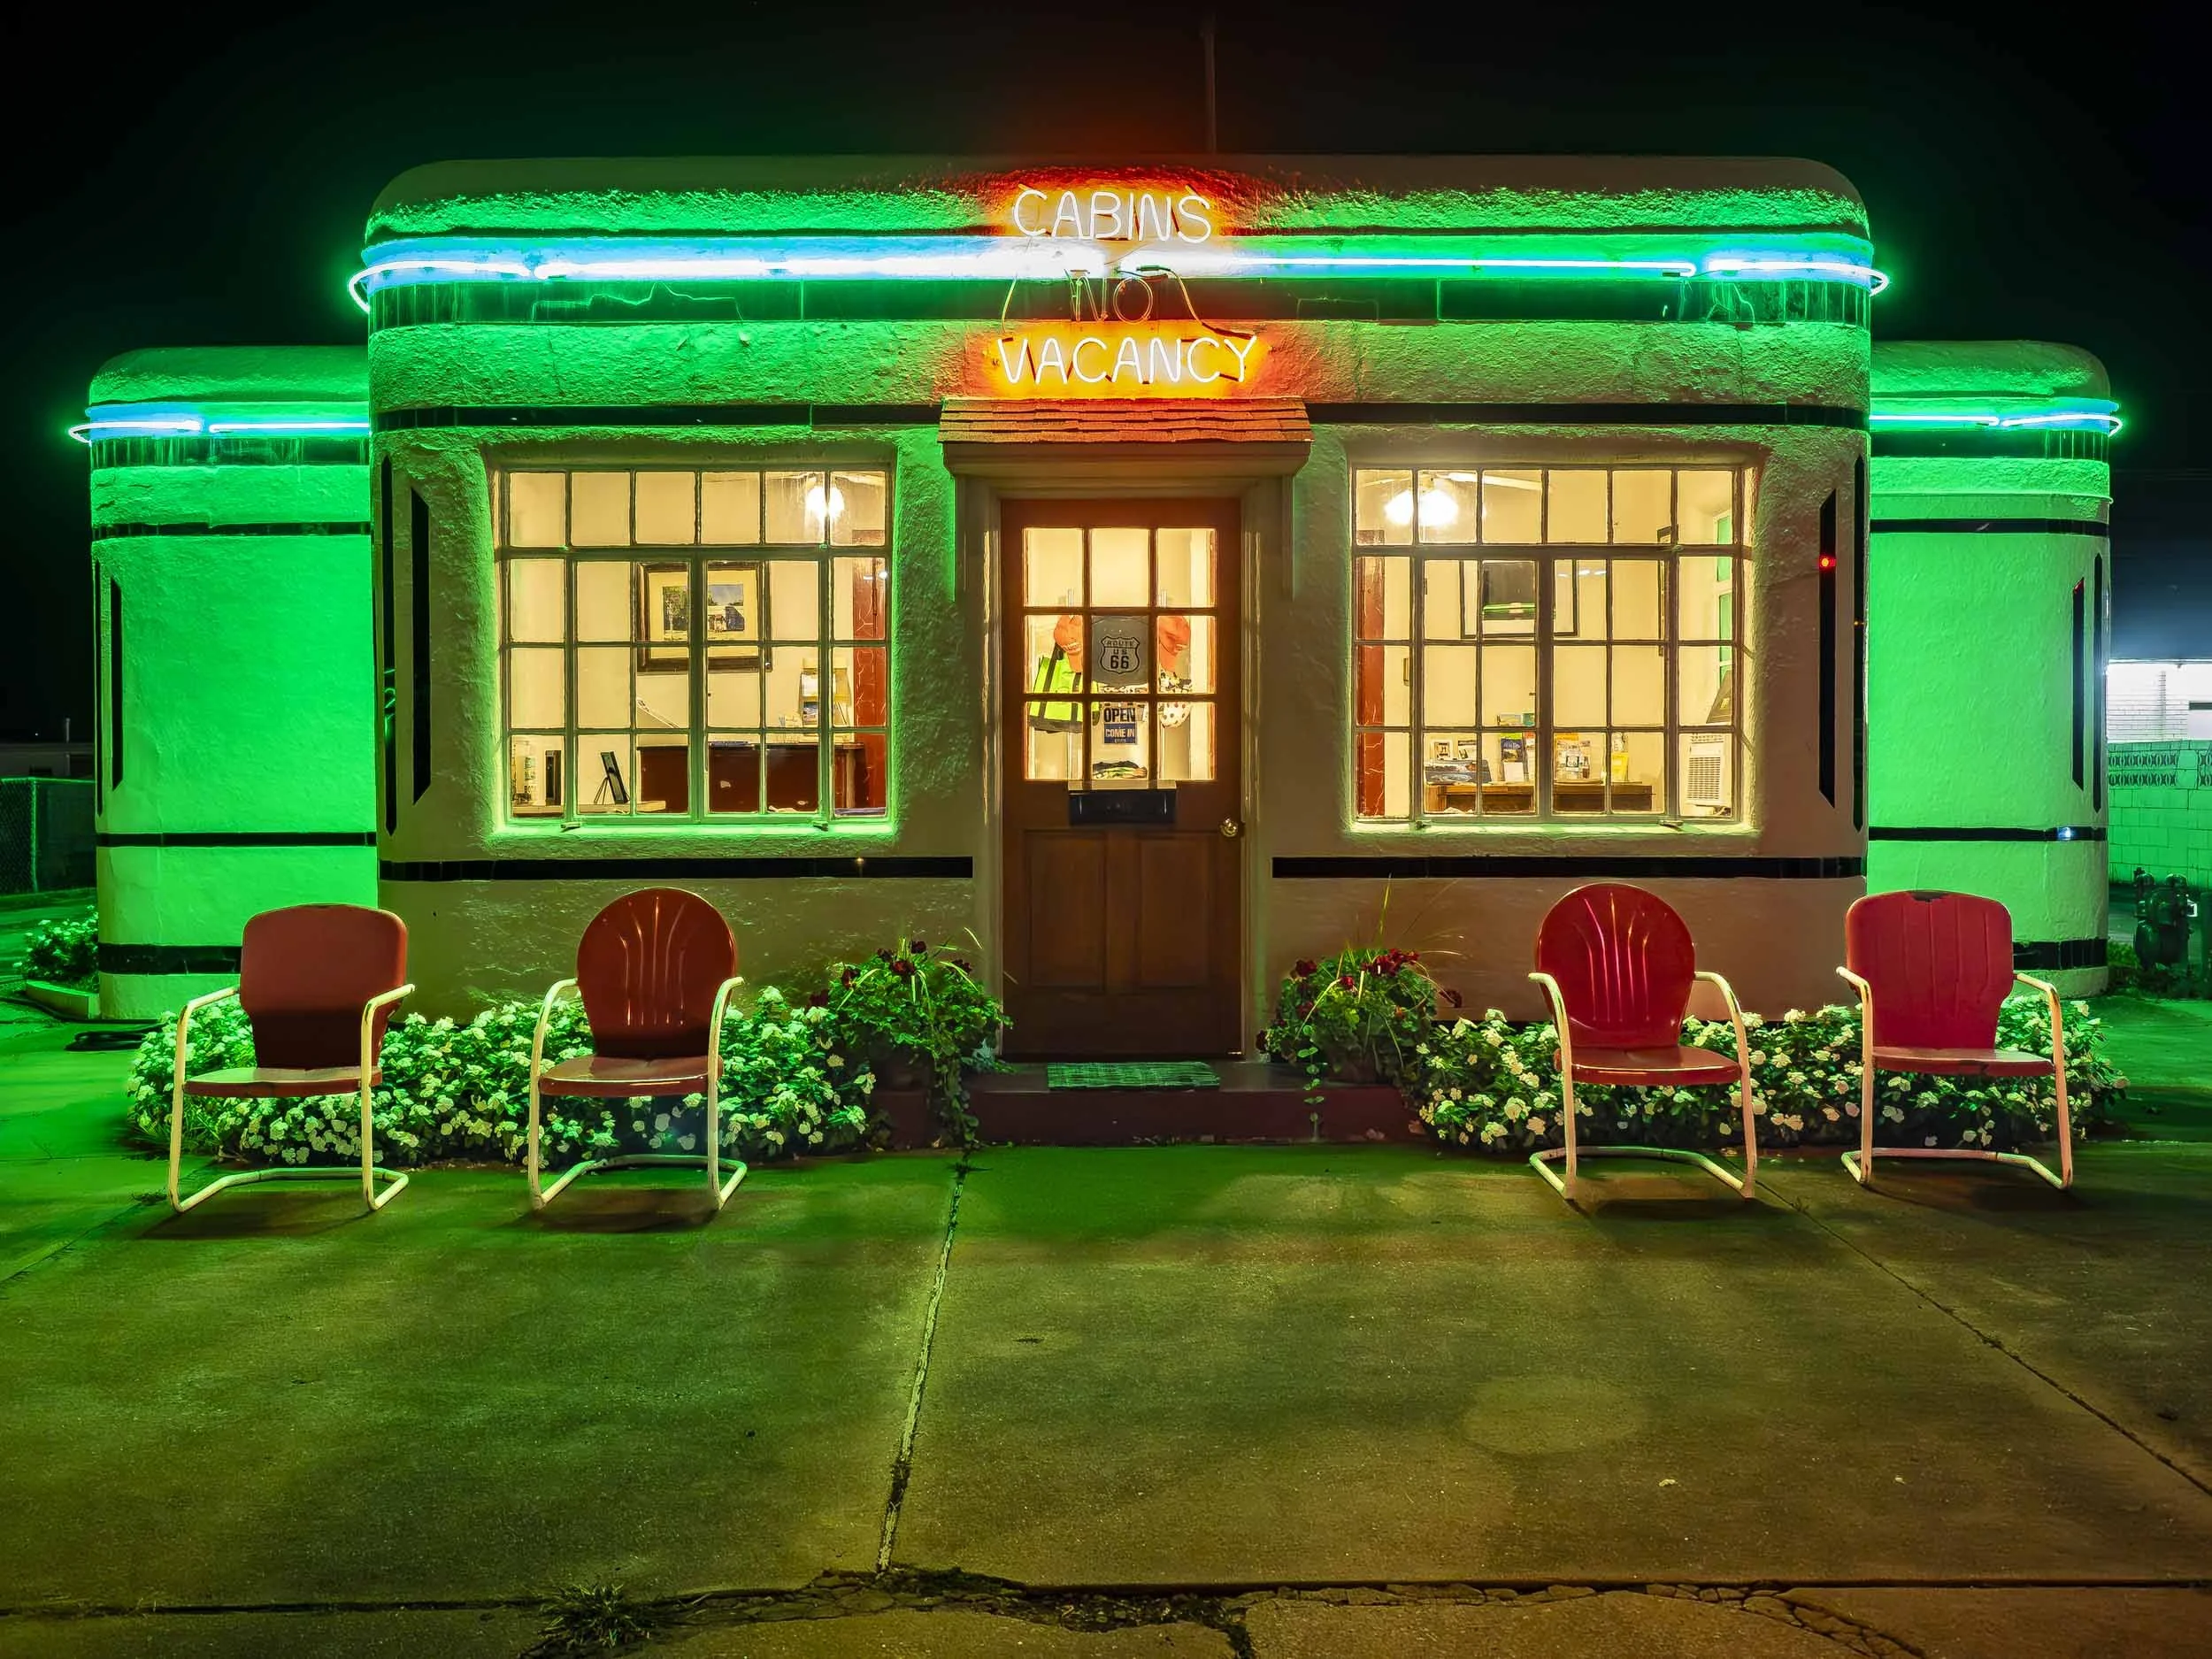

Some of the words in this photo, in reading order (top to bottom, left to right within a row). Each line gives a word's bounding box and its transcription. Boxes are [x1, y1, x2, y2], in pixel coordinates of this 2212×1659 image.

[1013, 189, 1211, 243] CABINS
[1074, 275, 1154, 324] NO
[997, 337, 1257, 384] VACANCY
[1110, 655, 1129, 669] 66
[1104, 708, 1136, 722] OPEN
[1105, 728, 1126, 738] COME
[1126, 728, 1135, 738] IN
